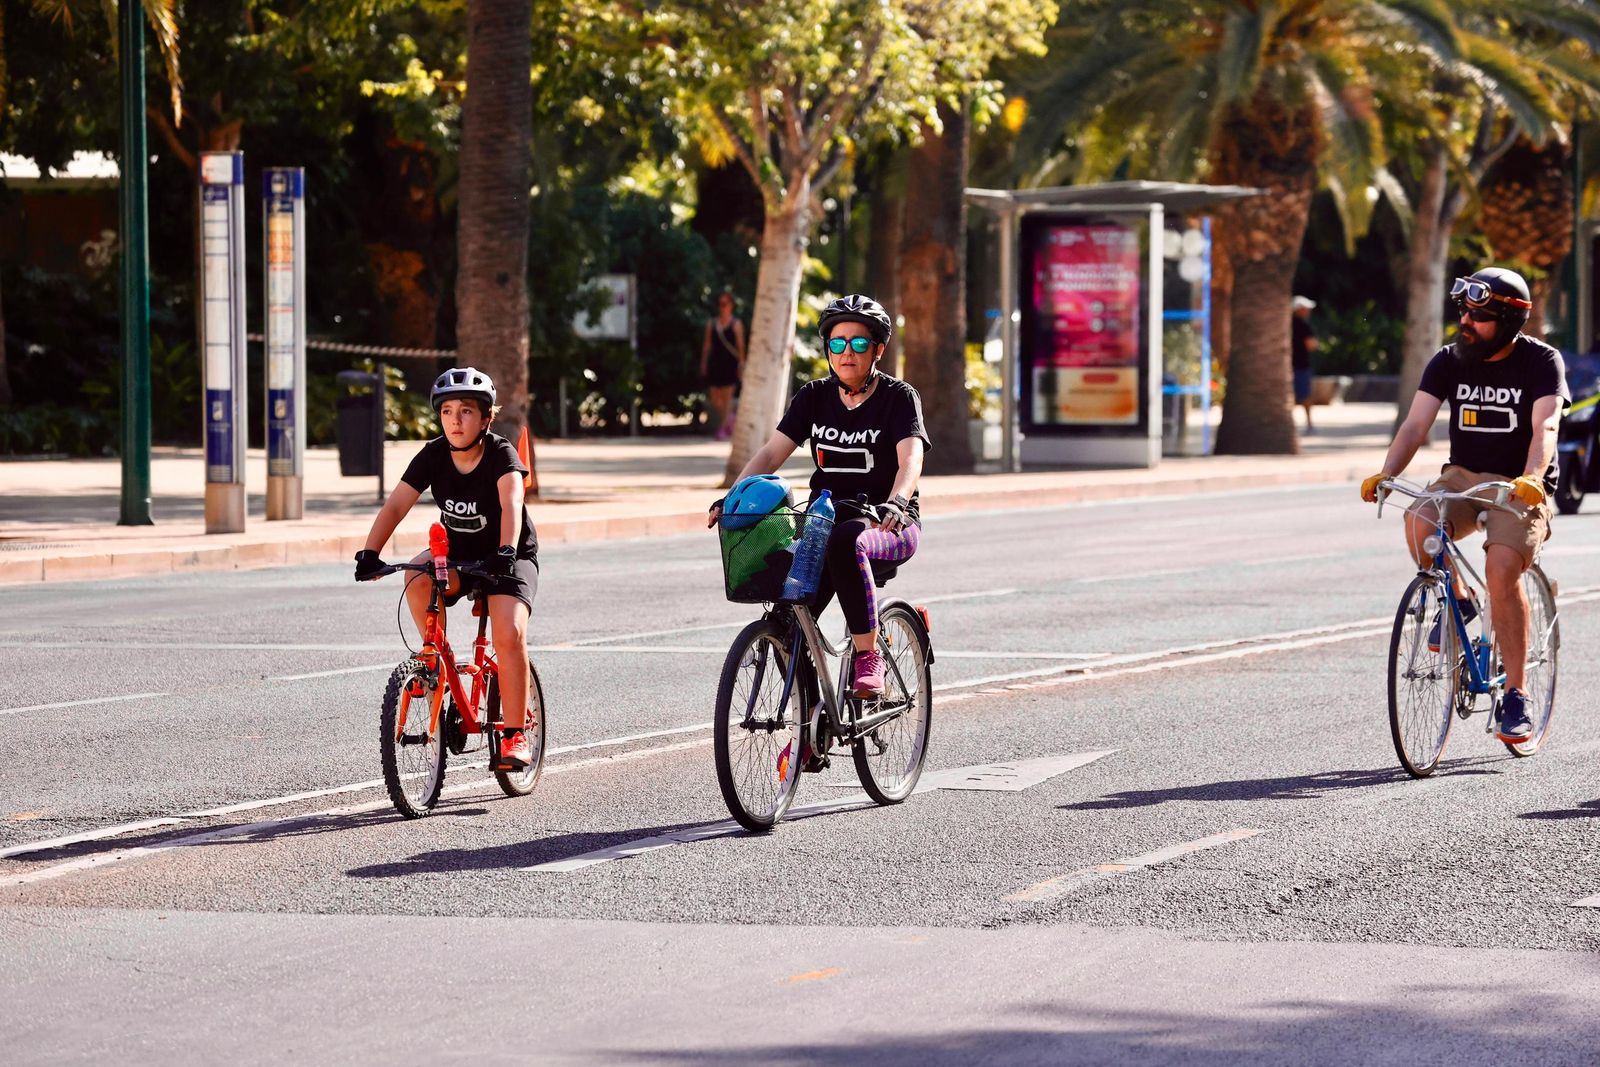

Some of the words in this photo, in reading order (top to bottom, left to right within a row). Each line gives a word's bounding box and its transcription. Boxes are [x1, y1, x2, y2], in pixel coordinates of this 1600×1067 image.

[1456, 383, 1523, 404] DADDY
[811, 423, 881, 444] MOMMY
[445, 499, 477, 515] SON
